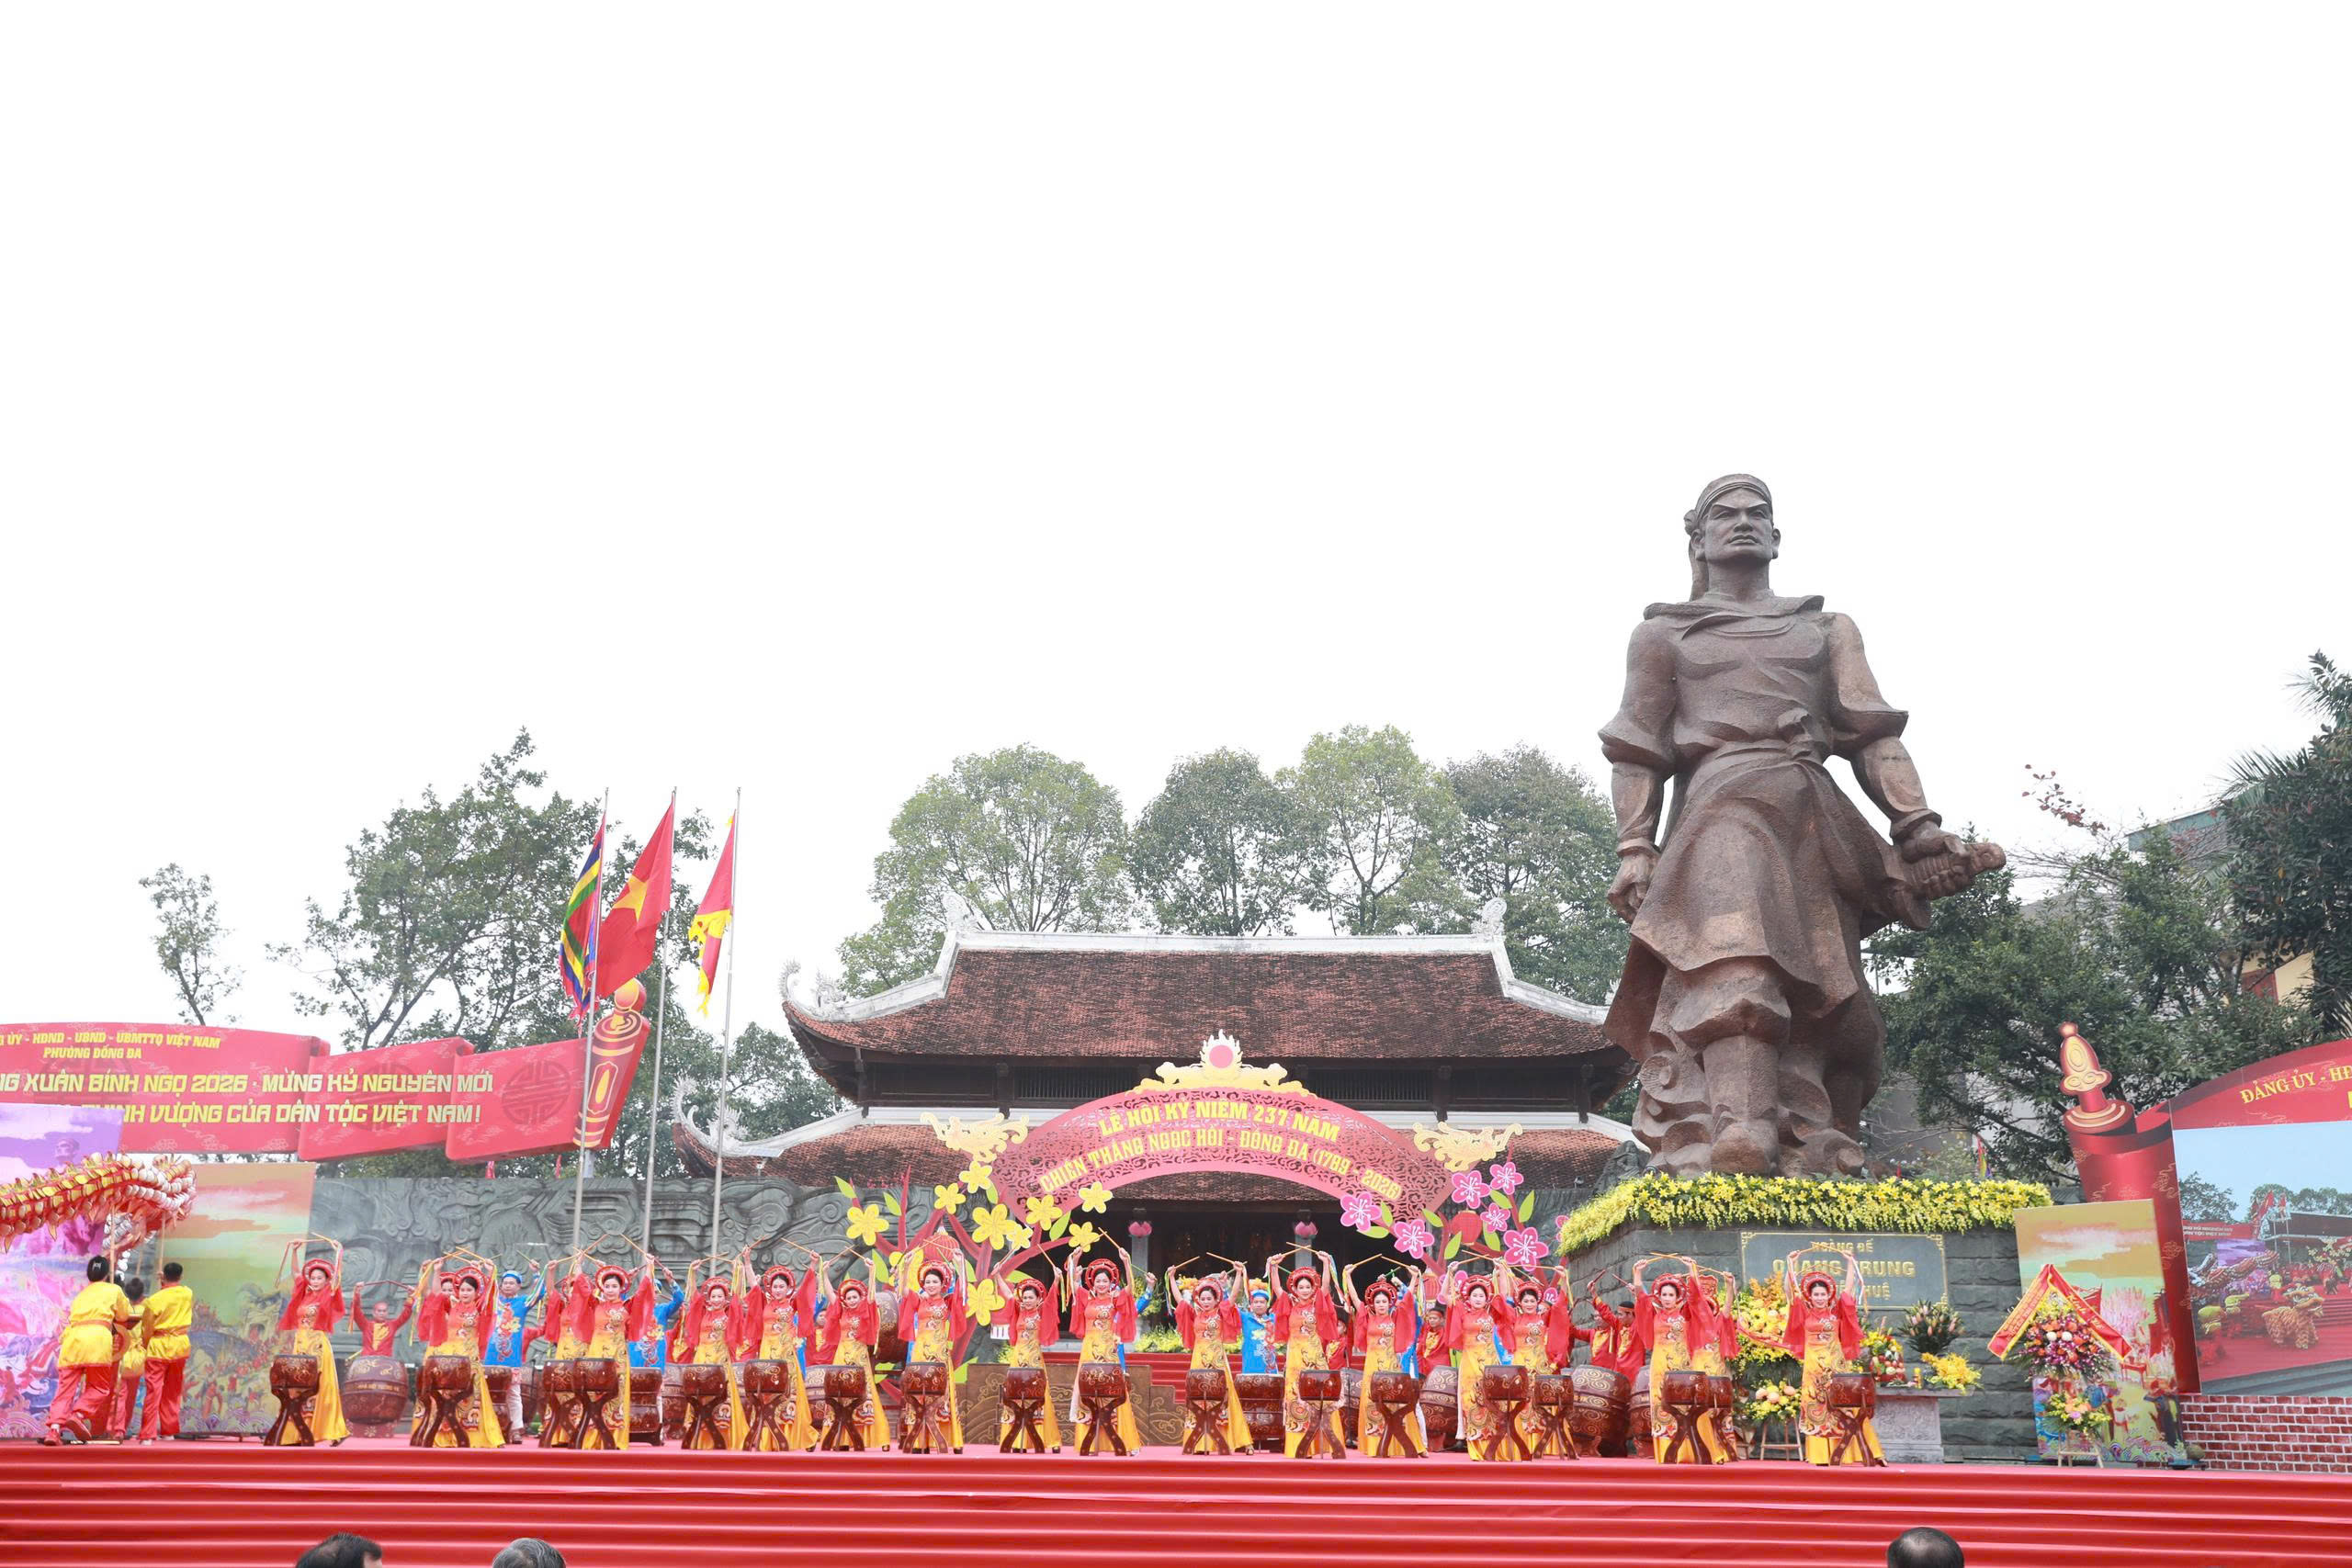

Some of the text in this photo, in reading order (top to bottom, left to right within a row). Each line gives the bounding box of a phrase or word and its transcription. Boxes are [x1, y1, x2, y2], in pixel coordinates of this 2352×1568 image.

[7, 1031, 22, 1045] ỦY
[74, 1032, 107, 1043] UBND
[117, 1032, 164, 1047] UBMTTQ
[166, 1032, 191, 1049] VIỆT
[193, 1035, 221, 1049] NAM
[126, 1047, 142, 1059] ĐA
[23, 1068, 85, 1092] XUÂN
[88, 1068, 140, 1092] BÍNH
[143, 1074, 187, 1098] NGỌ
[190, 1074, 248, 1093] 2026
[262, 1066, 323, 1093] MỪNG
[327, 1067, 358, 1092] KỶ
[362, 1069, 452, 1093] NGUYÊN
[457, 1068, 493, 1092] MỚI
[2240, 1080, 2290, 1104] ĐẢNG
[2292, 1068, 2316, 1089] ỦY
[150, 1101, 223, 1128] VƯỢNG
[226, 1098, 272, 1122] CỦA
[276, 1099, 321, 1122] DÂN
[325, 1099, 368, 1128] TỘC
[372, 1099, 423, 1128] VIỆT
[1099, 1097, 1340, 1143] LỄ HỘI KỶ NIỆM 237 NĂM
[1148, 1130, 1192, 1153] NGỌC
[1239, 1126, 1283, 1154] ĐỐNG
[1286, 1139, 1309, 1161] ĐA
[1312, 1148, 1352, 1176] (1789
[1857, 1237, 1874, 1253] ĐẾ
[1854, 1259, 1916, 1278] RUNG
